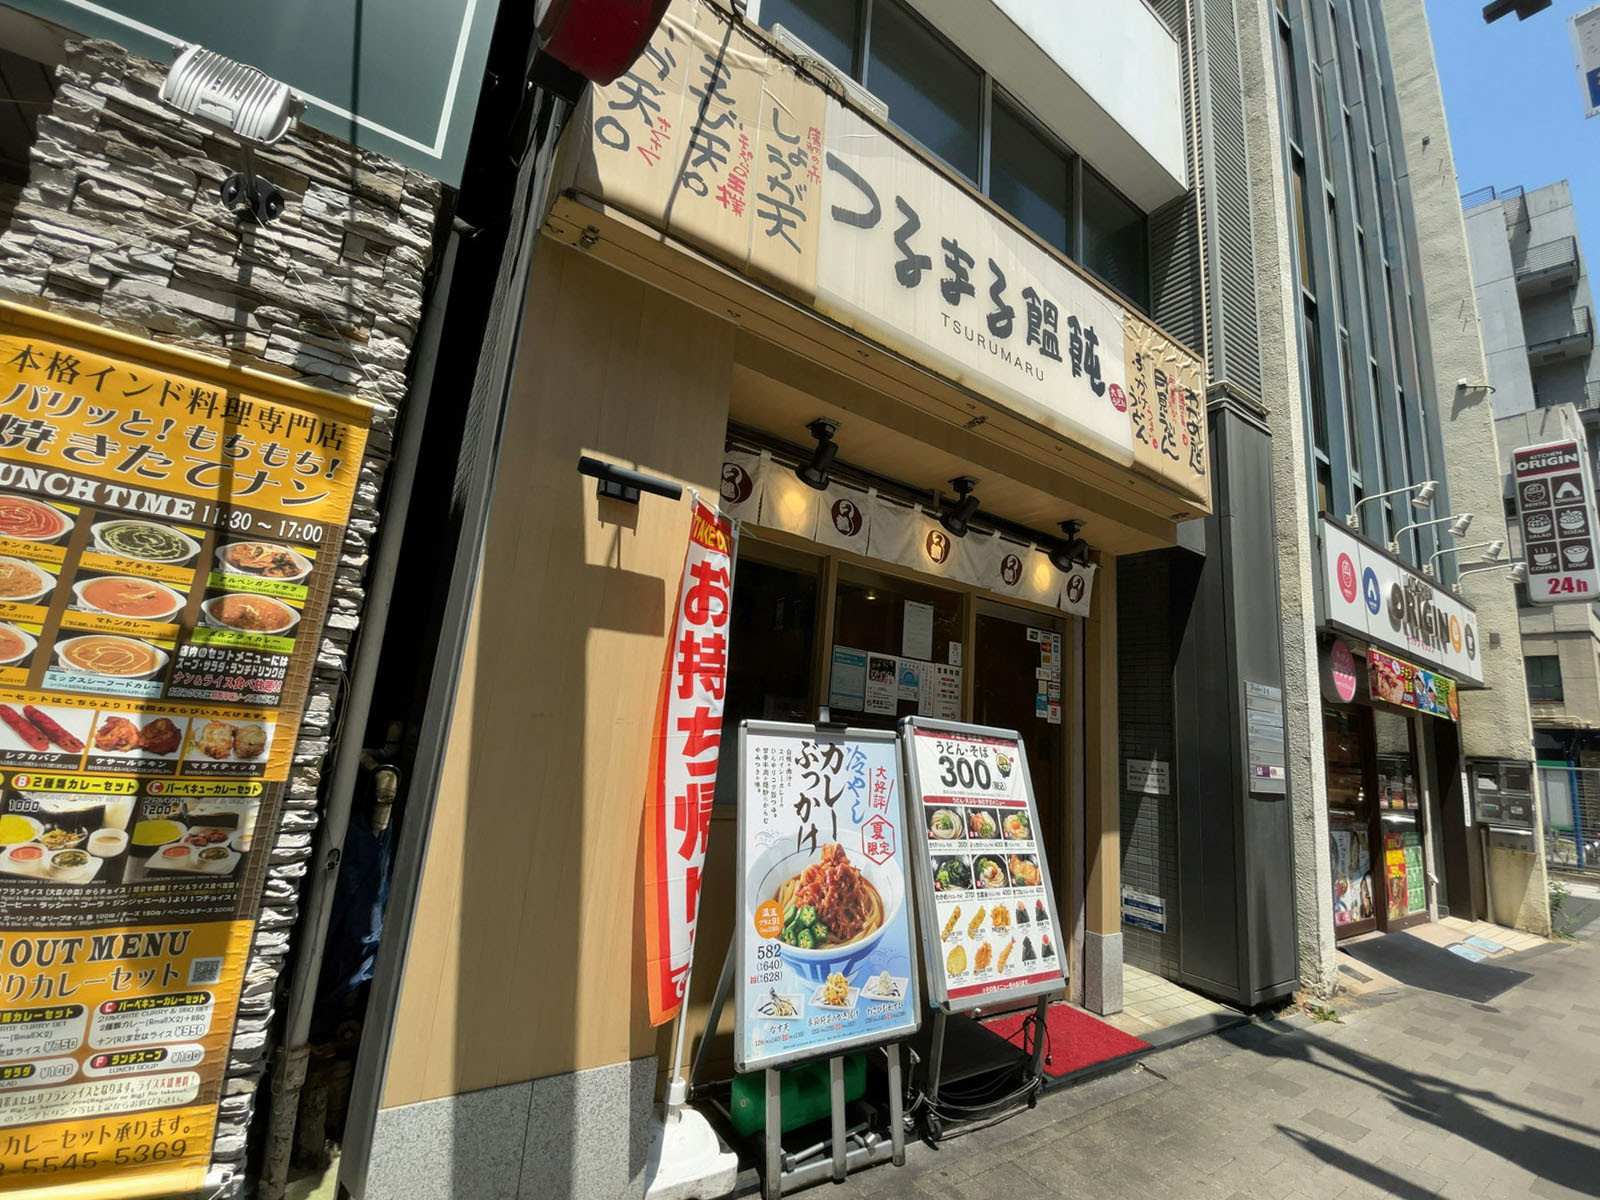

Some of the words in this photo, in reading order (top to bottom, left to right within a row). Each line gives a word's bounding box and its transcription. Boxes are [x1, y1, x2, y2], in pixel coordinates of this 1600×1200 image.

[940, 311, 1045, 382] TSURUMARU
[7, 344, 348, 451] 本格インド料理専門店
[0, 413, 330, 507] 焼きたてナン
[1516, 452, 1579, 471] ORIGIN
[1529, 450, 1563, 461] KITCHEN
[103, 484, 197, 521] TIME
[202, 504, 252, 532] 11:30
[278, 515, 323, 543] 17:00
[1530, 564, 1558, 573] COFFEE
[1567, 560, 1589, 569] SOUP
[1547, 576, 1589, 596] 24h
[96, 616, 152, 629] マトンカレー
[1391, 582, 1450, 644] ORIGIN
[178, 644, 289, 668] 店内のセットメニューには
[821, 742, 845, 841] カレー
[846, 745, 867, 824] 冷やし
[873, 765, 888, 810] 大好評
[938, 755, 992, 790] 300
[794, 741, 821, 857] ぶっかけ
[10, 935, 83, 968] OUT
[87, 930, 192, 963] MENU
[757, 943, 782, 960] 582
[0, 963, 180, 1001] りカレーセット
[111, 1050, 163, 1066] ランチスープ
